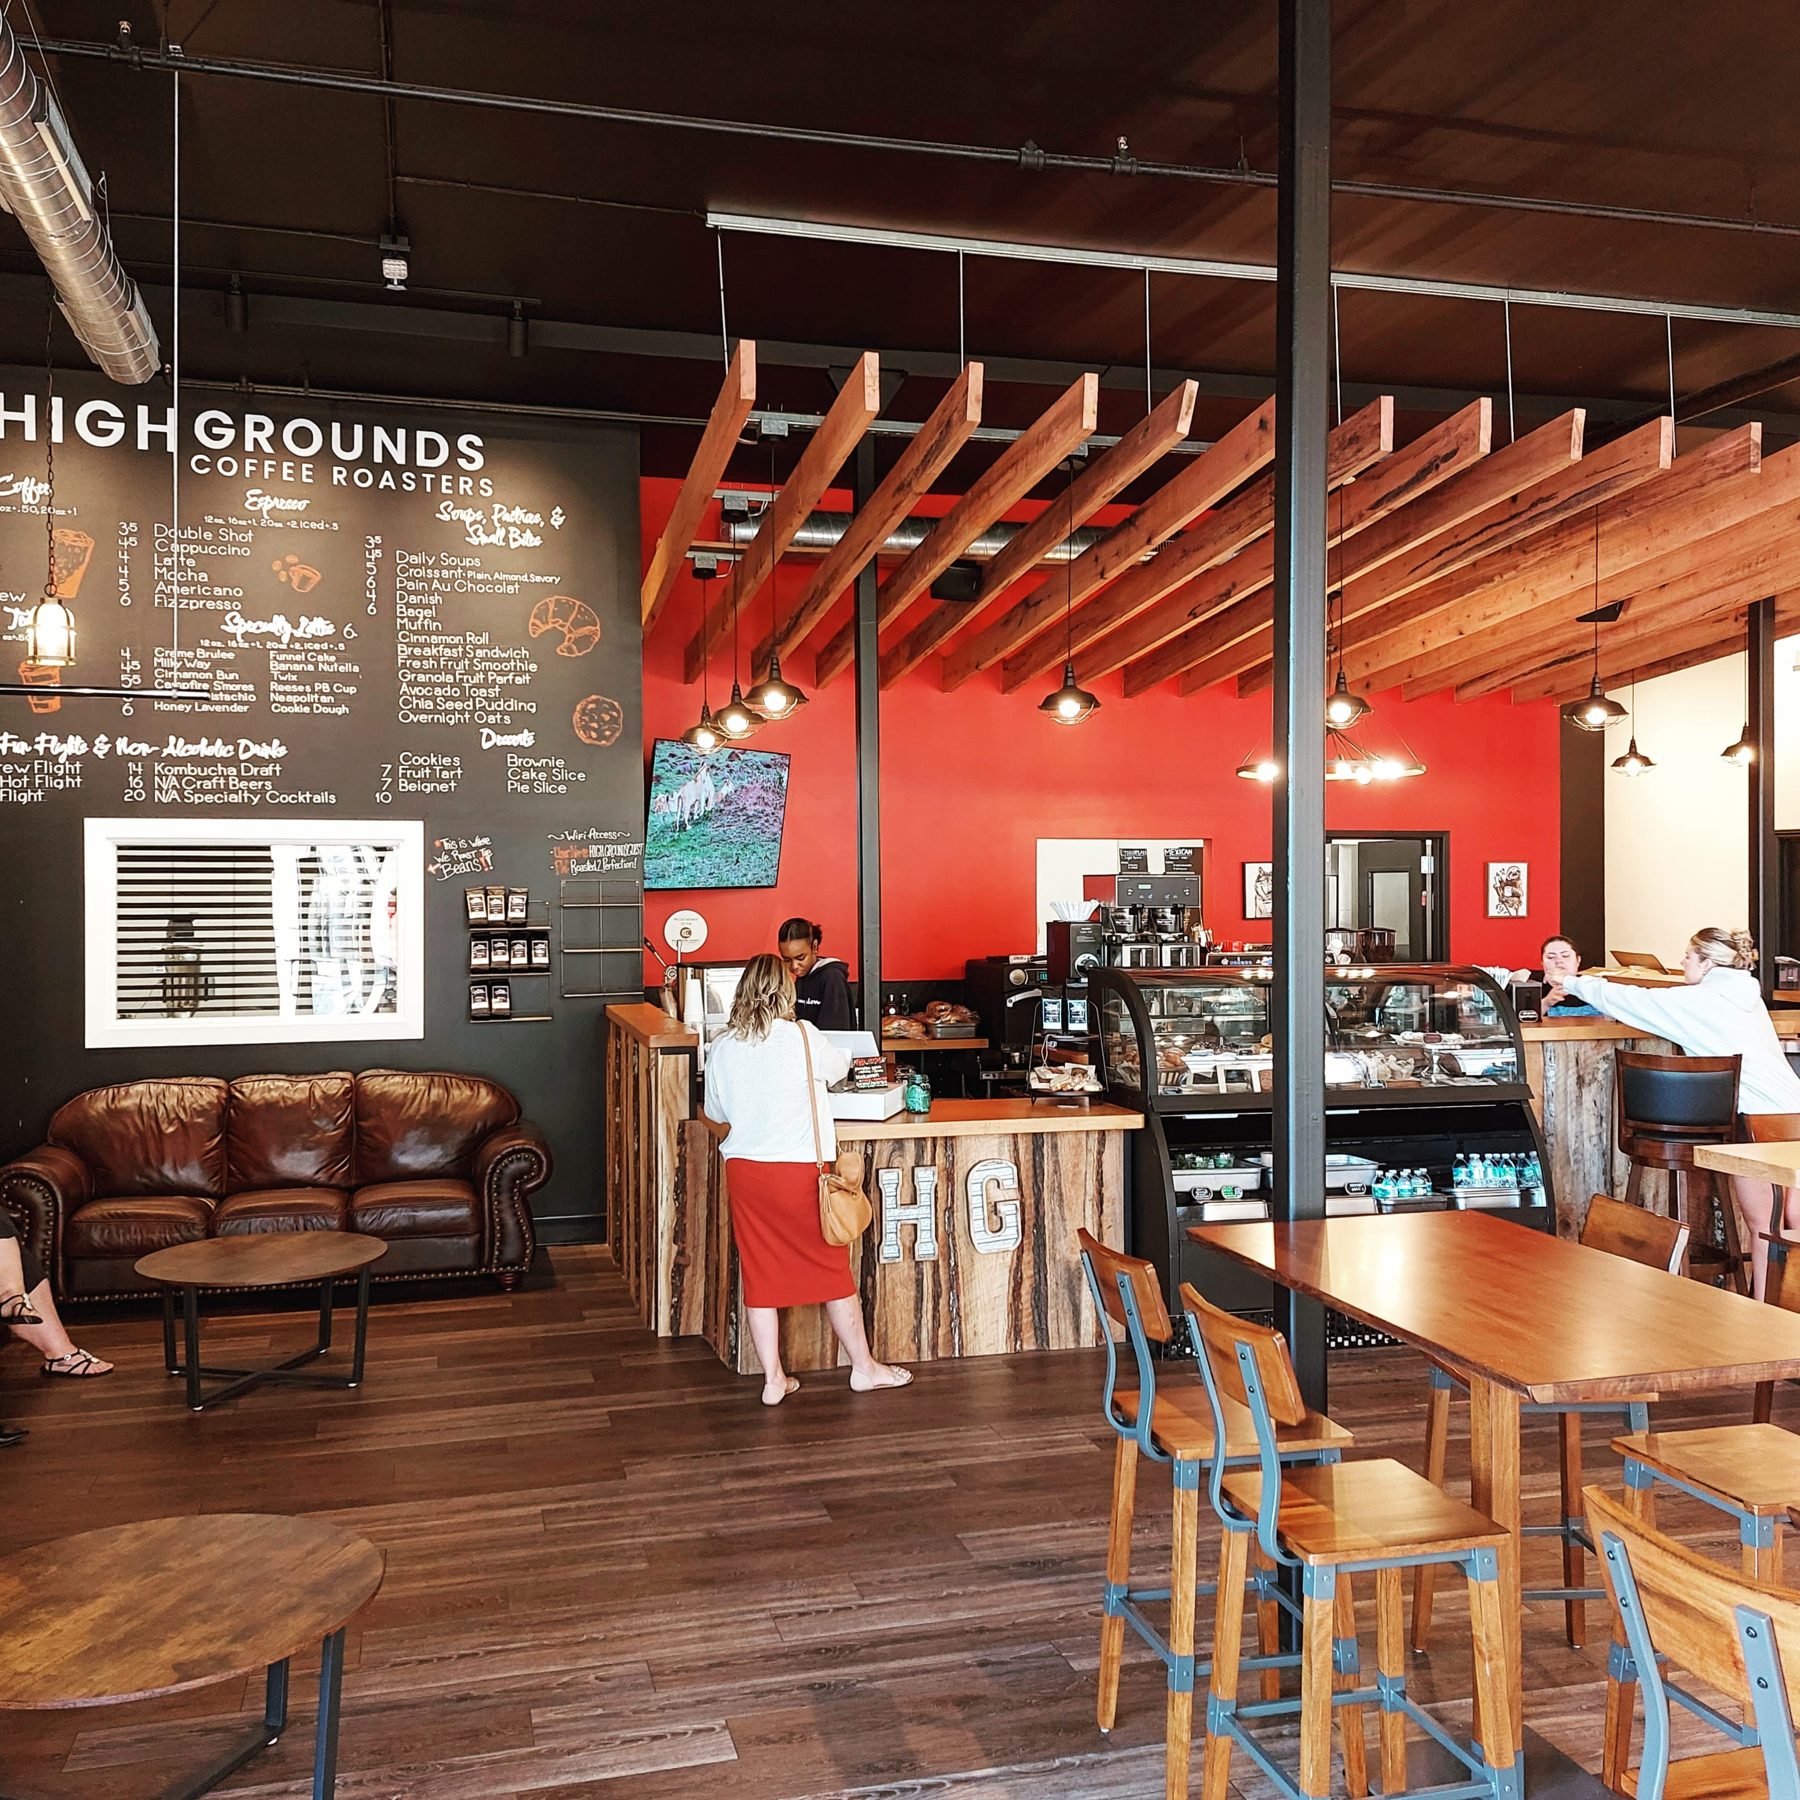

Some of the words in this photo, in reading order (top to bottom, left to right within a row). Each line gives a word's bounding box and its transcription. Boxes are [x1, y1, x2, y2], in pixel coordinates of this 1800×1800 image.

[0, 392, 175, 452] HIGH
[194, 410, 485, 471] GROUNDS
[190, 454, 314, 483] COFFEE
[332, 466, 494, 497] ROASTERS
[244, 488, 311, 519] Espresso
[550, 505, 567, 530] &
[154, 523, 213, 541] Double
[219, 527, 254, 543] Shot
[465, 524, 506, 546] Small
[508, 526, 544, 549] Bites
[155, 538, 251, 556] Cappuccino
[118, 550, 130, 563] 4
[396, 550, 436, 566] Daily
[440, 552, 481, 567] Soups
[118, 565, 130, 578] 4
[154, 566, 208, 582] Mocha
[366, 562, 377, 575] 5
[118, 579, 130, 592] 5
[155, 580, 243, 597] Americano
[366, 576, 376, 588] 6
[396, 577, 428, 590] Pain
[431, 579, 451, 591] Au
[454, 579, 520, 594] Chocolat
[120, 593, 132, 607] 6
[154, 594, 241, 611] Fizzpresso
[366, 589, 376, 602] 4
[396, 591, 443, 604] Danish
[367, 602, 377, 615] 6
[396, 604, 436, 619] Bagel
[220, 611, 292, 643] Specialty
[396, 618, 442, 631] Muffin
[398, 630, 463, 644] Cinnamon
[466, 632, 489, 645] Roll
[120, 647, 131, 660] 4
[196, 648, 235, 659] Brulee
[269, 651, 305, 661] Funnel
[307, 653, 336, 662] Cake
[397, 644, 463, 657] Breakfast
[465, 646, 530, 658] Sandwich
[184, 659, 211, 669] Way
[269, 661, 314, 671] Banana
[318, 663, 360, 672] Nutella
[397, 656, 437, 669] Fresh
[440, 657, 470, 670] Fruit
[472, 659, 538, 672] Smoothie
[154, 668, 213, 679] Cinnamon
[216, 670, 239, 680] Bun
[270, 671, 297, 681] Twix
[398, 669, 453, 683] Granola
[455, 671, 485, 684] Fruit
[488, 672, 531, 684] Parfait
[270, 682, 311, 692] Reeses
[314, 683, 330, 693] PB
[333, 683, 357, 695] Cup
[399, 682, 460, 697] Avocado
[462, 683, 501, 697] Toast
[210, 692, 257, 702] istachio
[270, 693, 334, 704] Neapolitan
[122, 703, 134, 716] 6
[154, 701, 192, 713] Honey
[194, 702, 250, 712] Lavender
[271, 703, 310, 713] Cookie
[313, 704, 349, 715] Dough
[399, 696, 433, 710] Chia
[436, 697, 473, 711] Seed
[475, 698, 537, 713] Pudding
[398, 710, 470, 725] Overnight
[474, 711, 511, 725] Oats
[0, 732, 32, 756] Fun
[93, 733, 112, 759] &
[237, 739, 288, 760] Drinks
[479, 728, 536, 750] Desserts
[400, 752, 461, 766] Cookies
[507, 754, 565, 767] Brownie
[34, 760, 83, 776] Flight
[128, 761, 143, 775] 14
[154, 762, 237, 776] Kombucha
[240, 763, 282, 776] Draft
[380, 764, 392, 778] 7
[399, 766, 431, 779] Fruit
[433, 767, 463, 780] Tart
[508, 768, 548, 781] Cake
[552, 769, 586, 782] Slice
[35, 774, 83, 790] Flight
[129, 776, 143, 788] 16
[154, 776, 180, 790] N/A
[181, 776, 226, 790] Craft
[229, 777, 272, 790] Beers
[381, 778, 392, 791] 7
[399, 778, 458, 793] Beignet
[507, 780, 530, 793] Pie
[533, 781, 567, 794] Slice
[0, 788, 45, 804] Flight
[124, 789, 146, 801] 20
[154, 789, 180, 803] N/A
[184, 790, 260, 805] Specialty
[266, 790, 337, 804] Cocktails
[375, 792, 392, 803] 10
[440, 838, 458, 850] This
[458, 837, 467, 849] is
[433, 851, 451, 863] We
